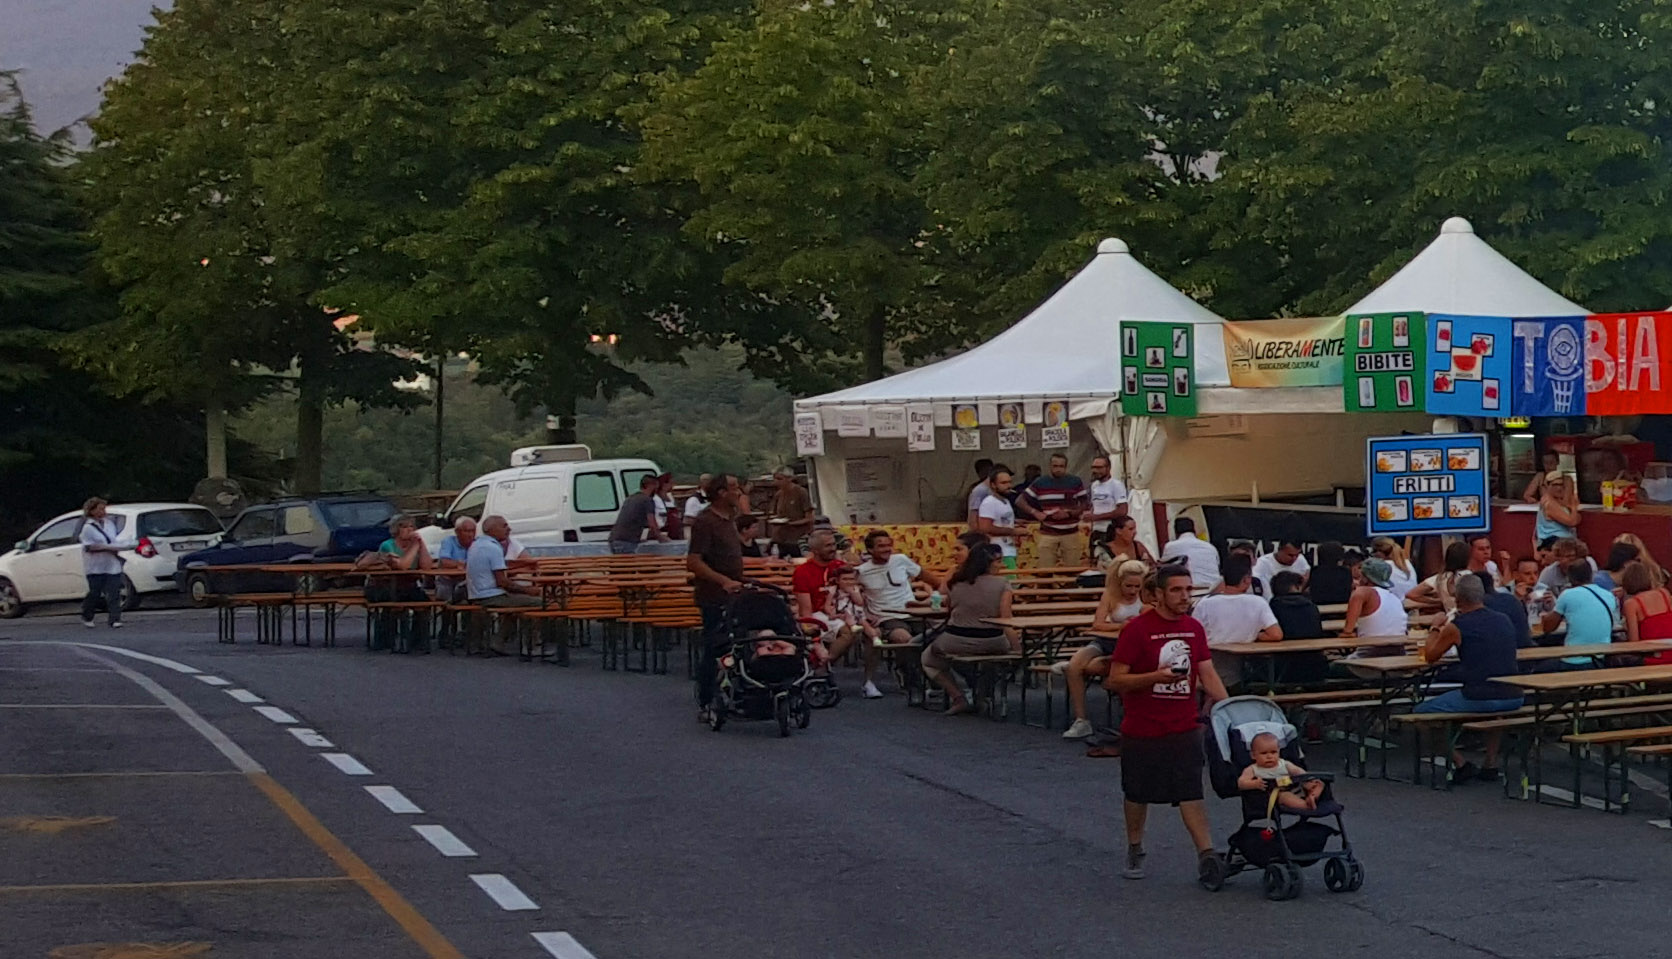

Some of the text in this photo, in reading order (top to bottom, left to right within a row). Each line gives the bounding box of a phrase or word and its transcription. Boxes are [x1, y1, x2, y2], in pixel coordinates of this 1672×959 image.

[1255, 337, 1345, 361] LIBERAMENTE
[1513, 316, 1660, 394] TOBIA
[1357, 352, 1413, 371] BIBITE
[1396, 476, 1451, 493] FRITTI
